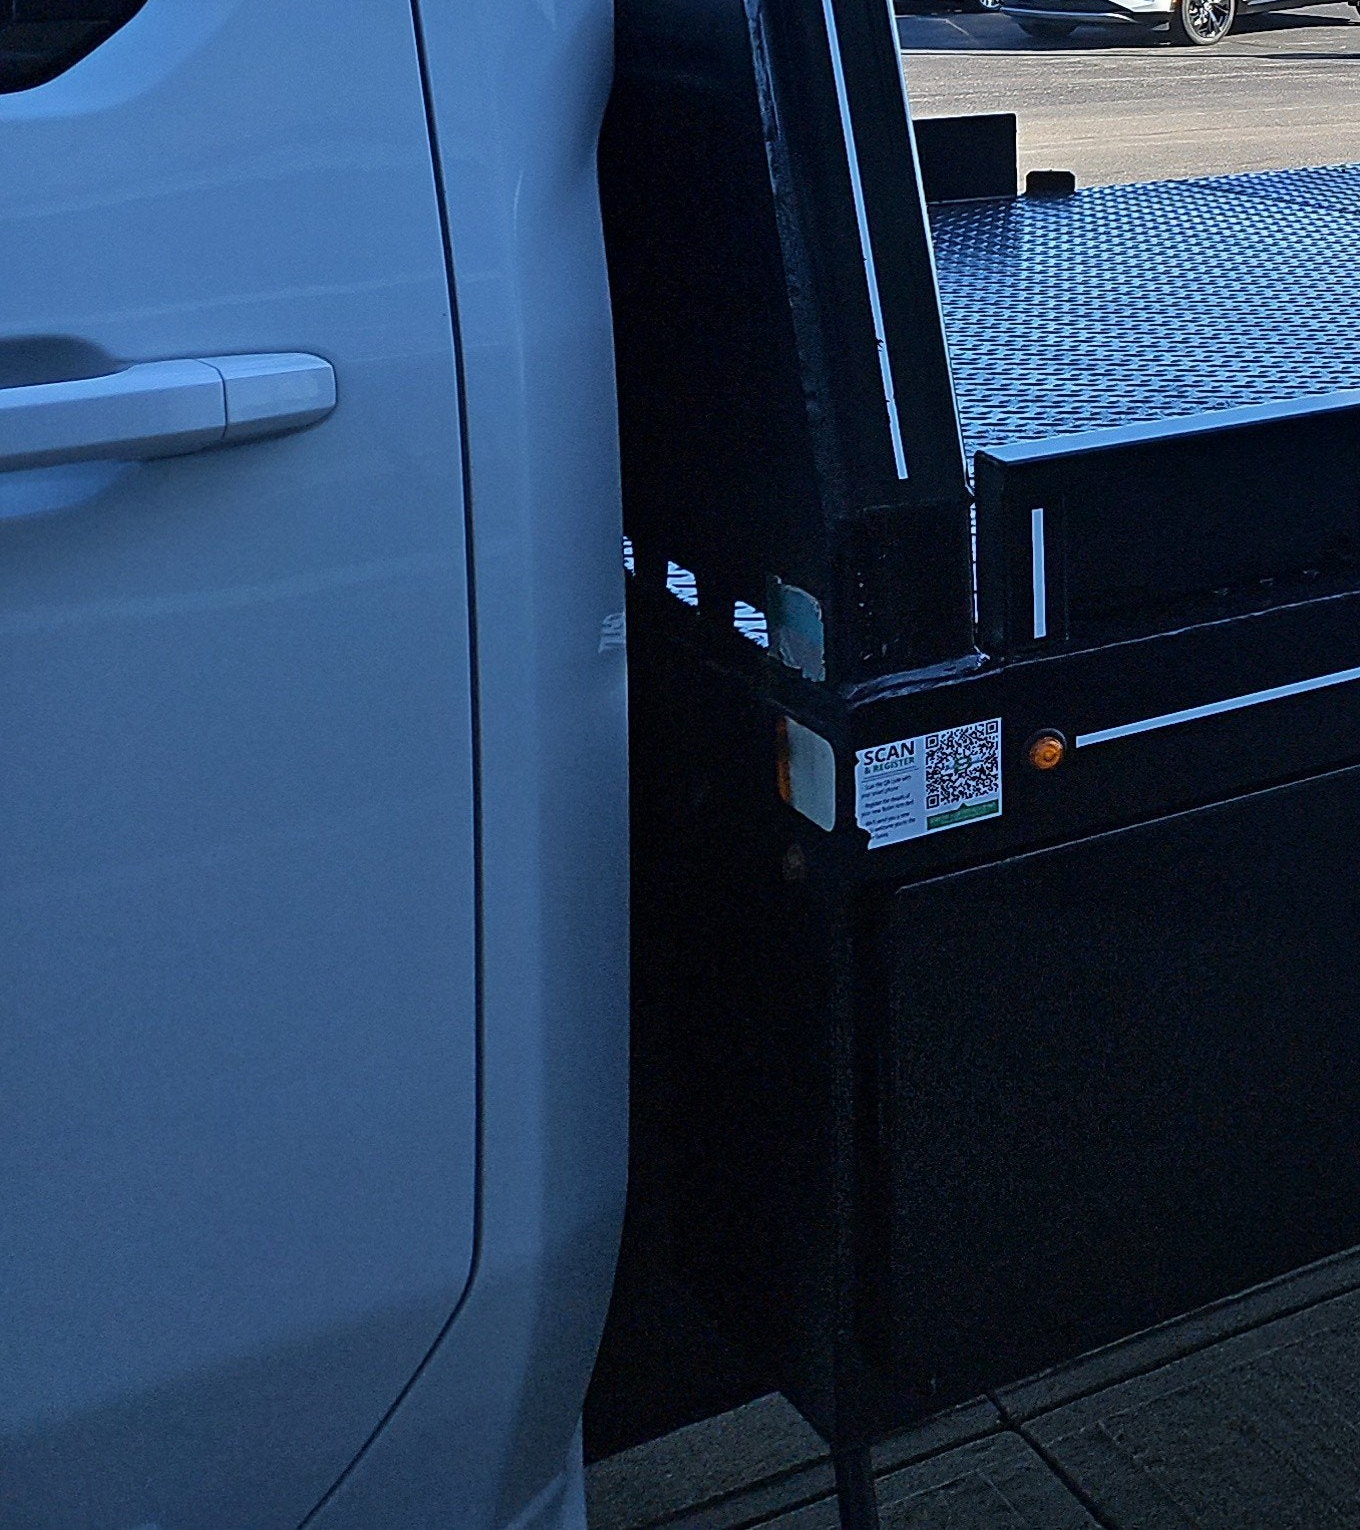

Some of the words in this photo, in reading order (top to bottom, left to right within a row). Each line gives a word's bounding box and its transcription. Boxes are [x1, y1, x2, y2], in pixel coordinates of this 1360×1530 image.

[863, 740, 915, 766] SCAN
[863, 766, 871, 775] &
[872, 756, 915, 773] REGISTER
